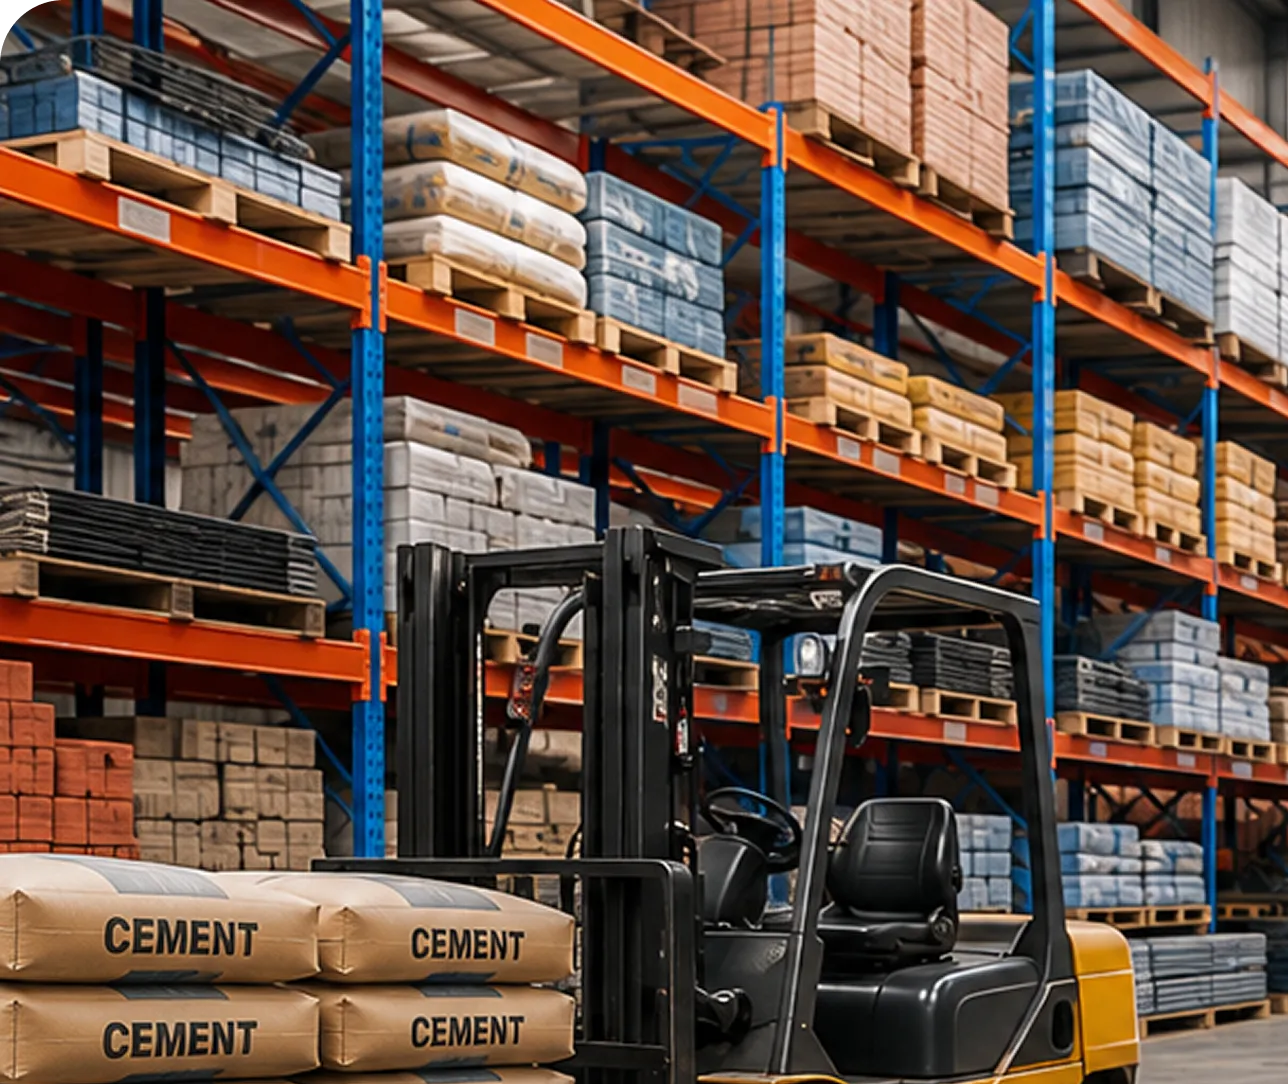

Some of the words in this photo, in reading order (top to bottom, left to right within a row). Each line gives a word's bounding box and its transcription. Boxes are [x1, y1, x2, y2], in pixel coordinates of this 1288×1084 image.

[104, 917, 258, 957] CEMENT
[411, 927, 525, 961] CEMENT
[103, 1021, 258, 1060] CEMENT
[411, 1015, 525, 1048] CEMENT
